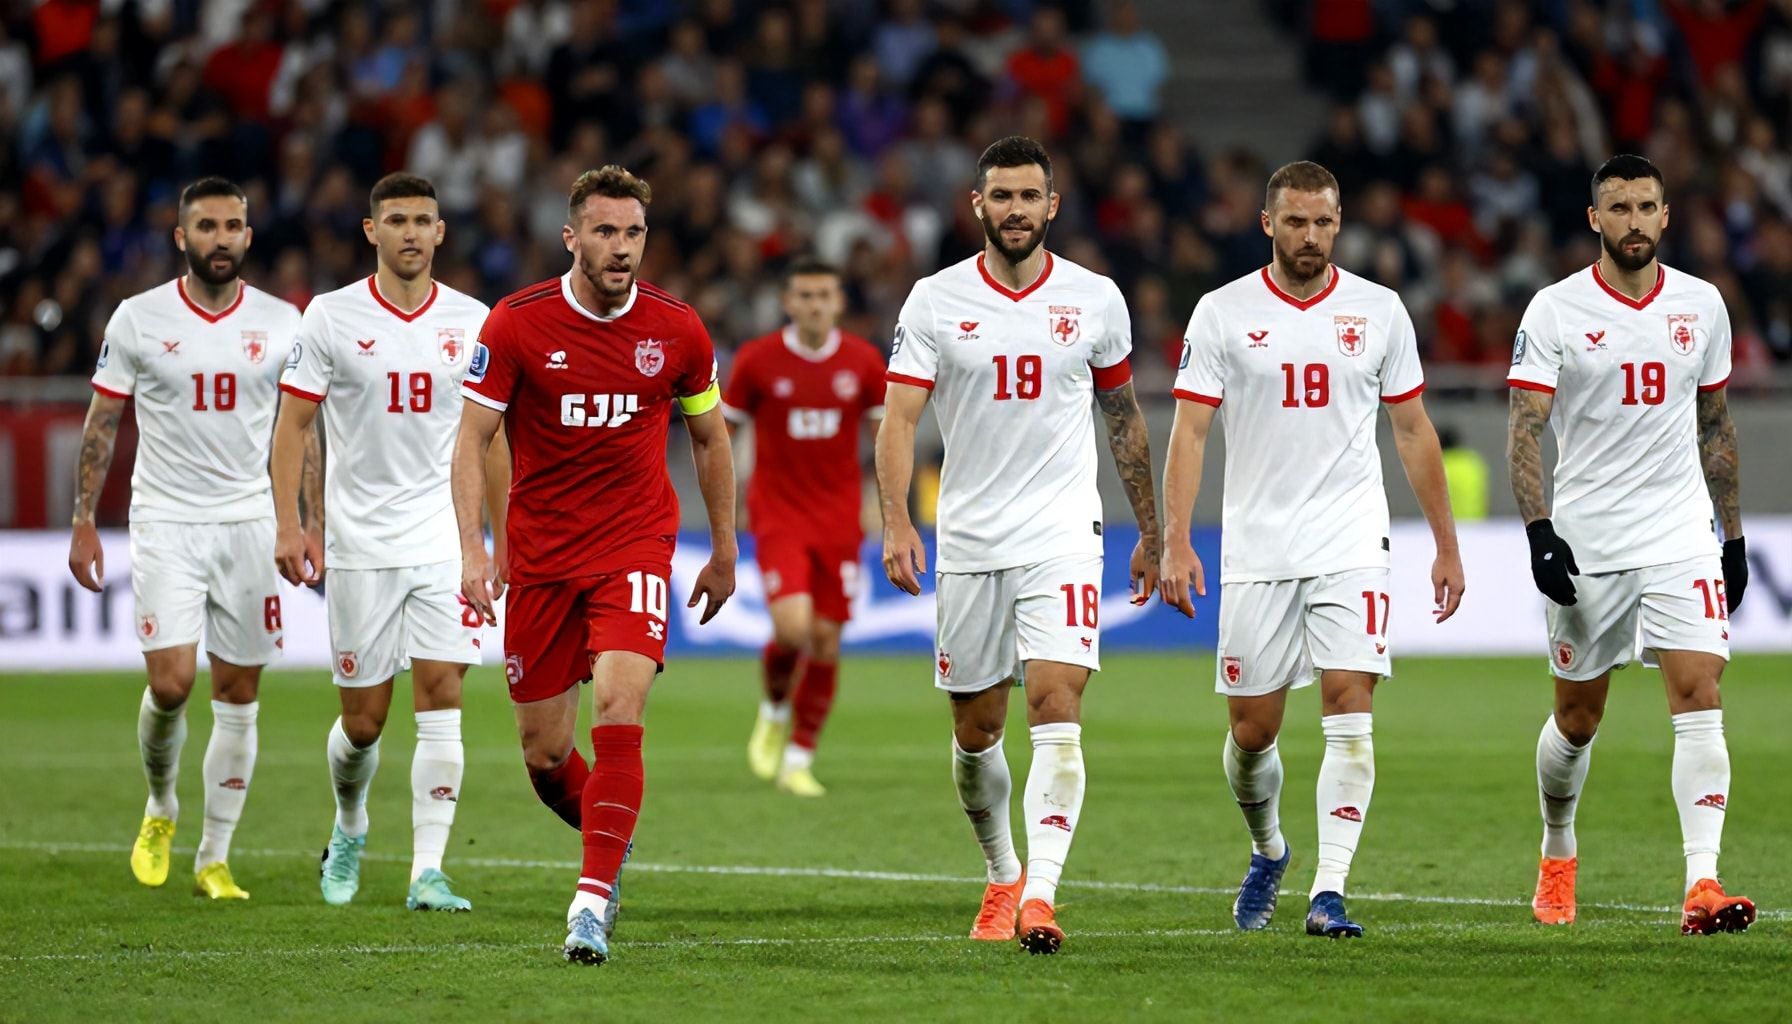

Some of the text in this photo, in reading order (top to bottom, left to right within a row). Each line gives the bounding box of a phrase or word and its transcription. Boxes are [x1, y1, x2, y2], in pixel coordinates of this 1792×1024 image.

[1622, 361, 1666, 405] 19
[627, 570, 667, 623] 10
[1060, 583, 1099, 630] 18
